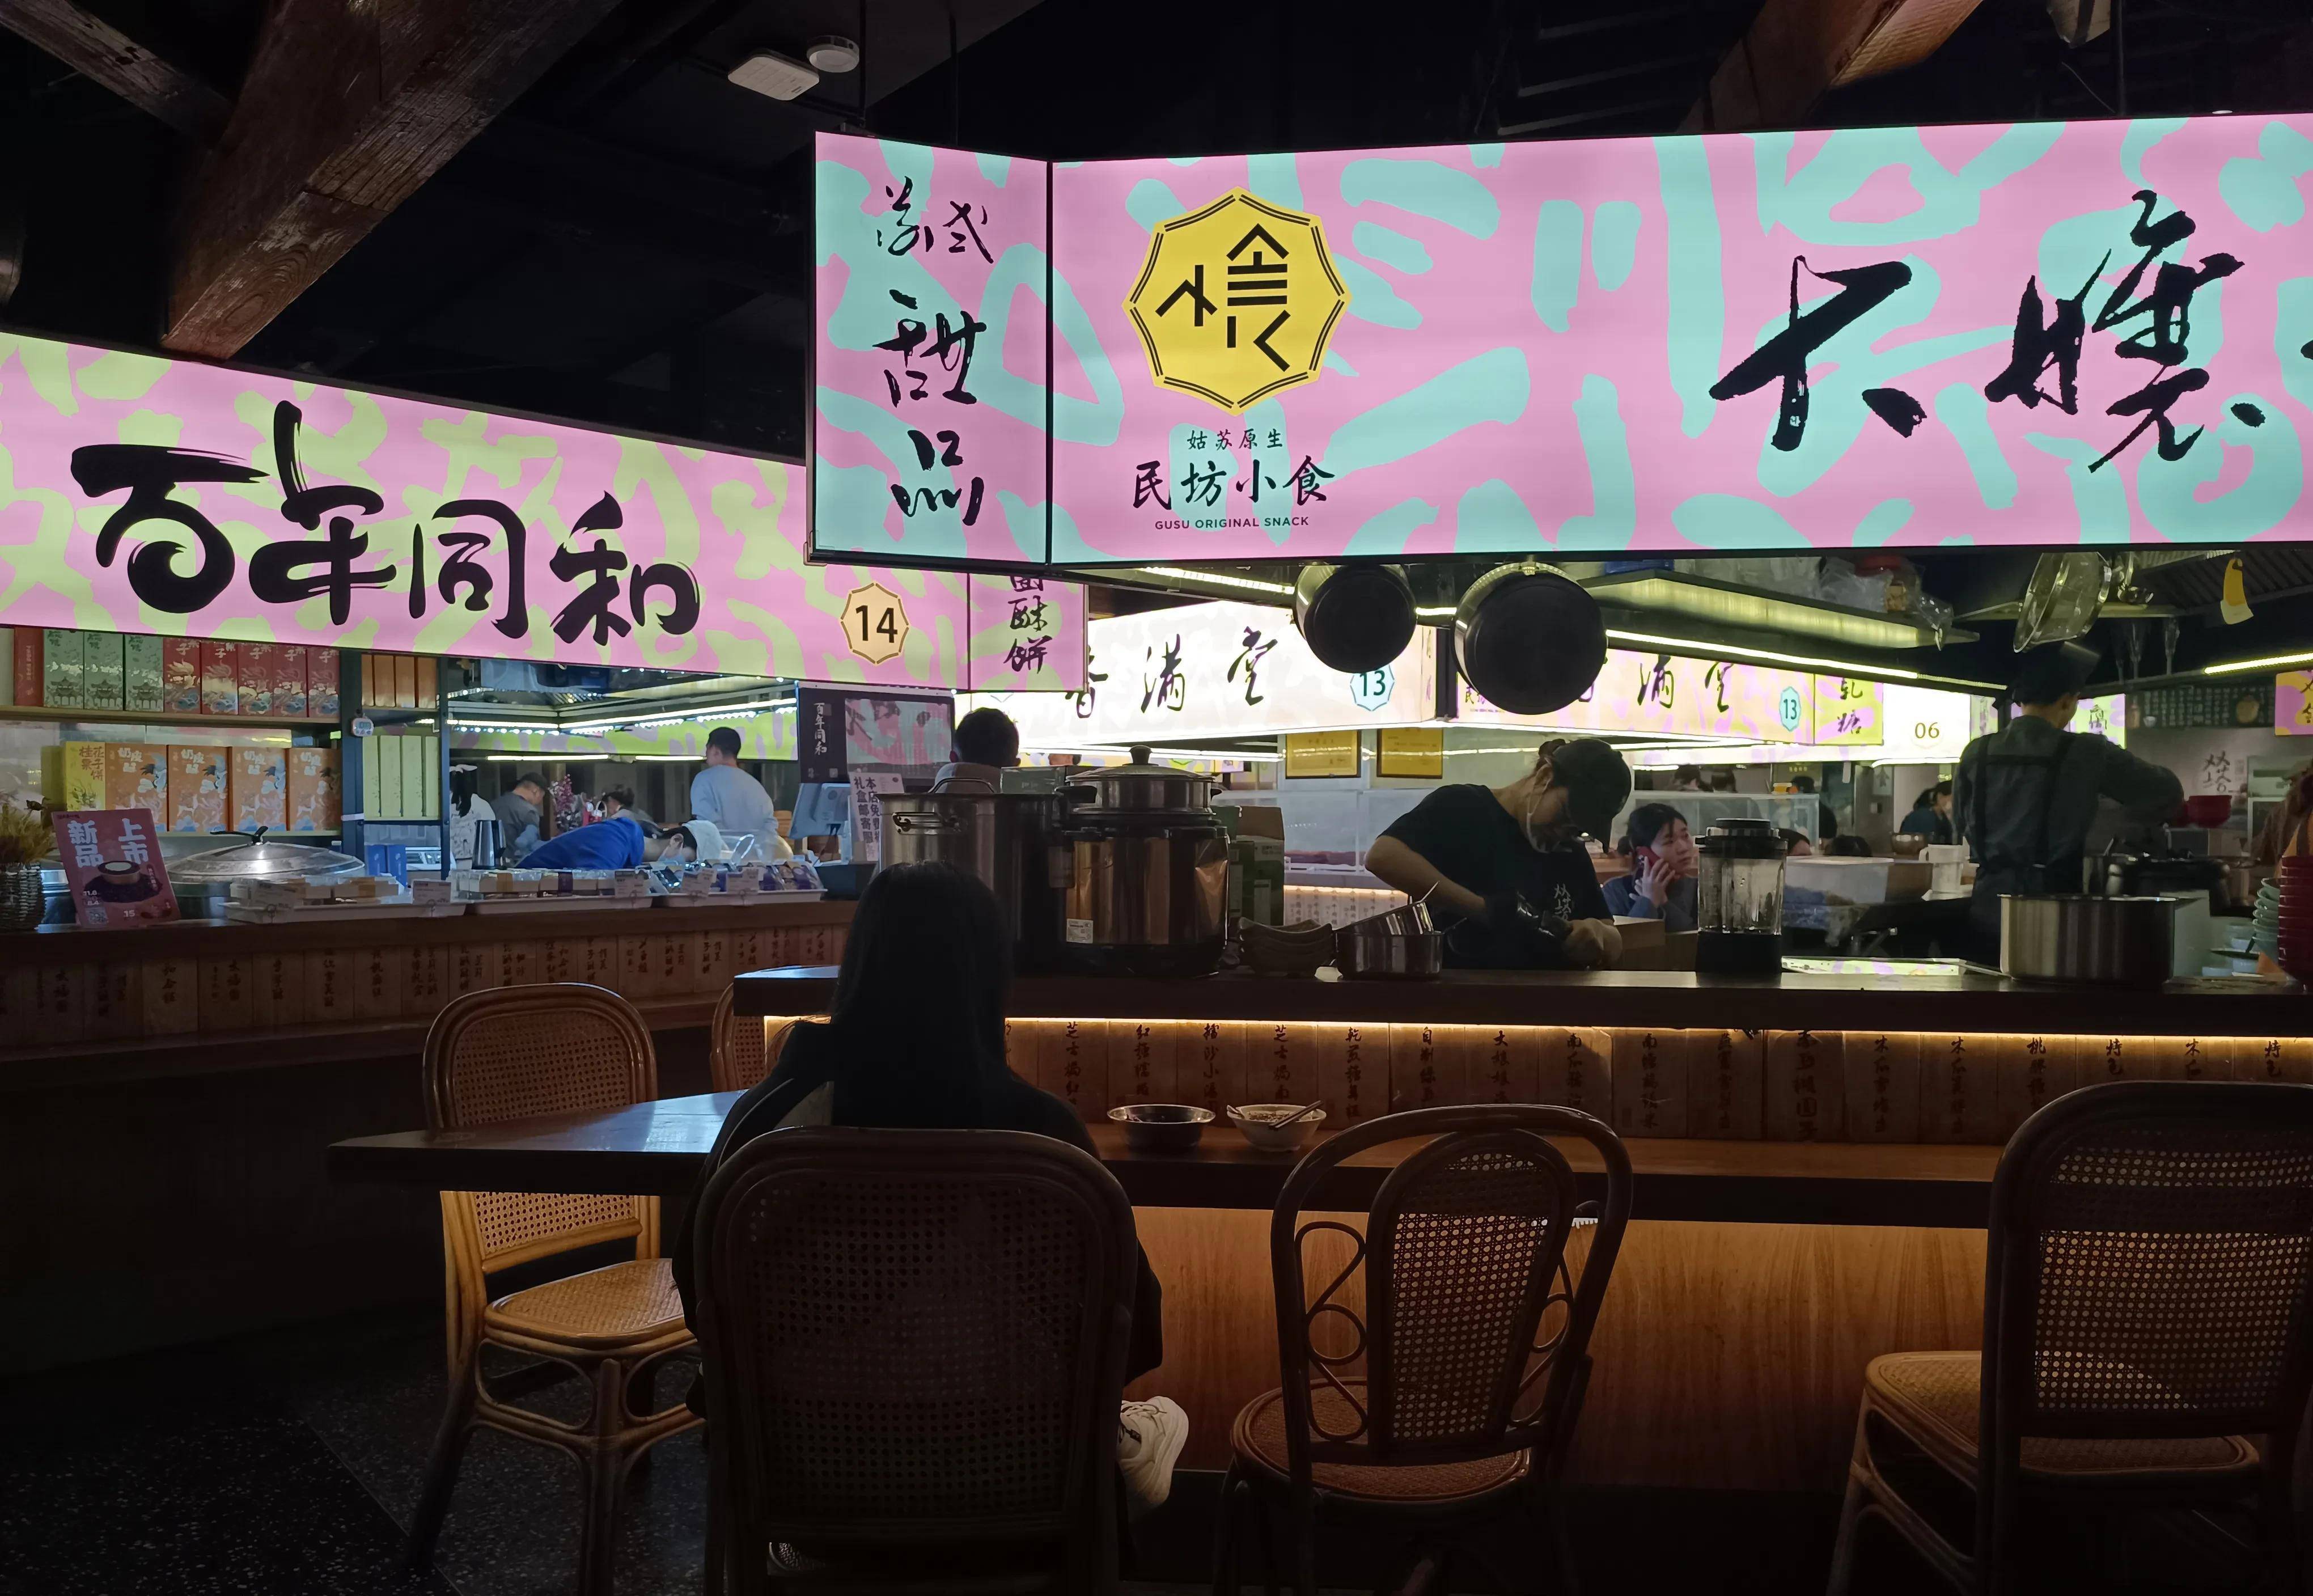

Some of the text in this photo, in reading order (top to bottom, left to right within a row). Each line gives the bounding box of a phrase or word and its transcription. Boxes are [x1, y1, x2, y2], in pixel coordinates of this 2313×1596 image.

[1187, 428, 1283, 450] 姑苏原生
[1133, 455, 1335, 510] 民坊小食
[70, 400, 701, 646] 百年同和
[1155, 516, 1309, 530] GUSU ORIGINAL SNACK
[855, 605, 898, 644] 14
[1359, 671, 1386, 697] 13
[1784, 698, 1797, 720] 13
[814, 702, 828, 756] 百年同和
[1914, 722, 1940, 739] 06
[67, 820, 104, 869] 新品
[118, 818, 149, 865] 上市
[123, 909, 135, 918] 15
